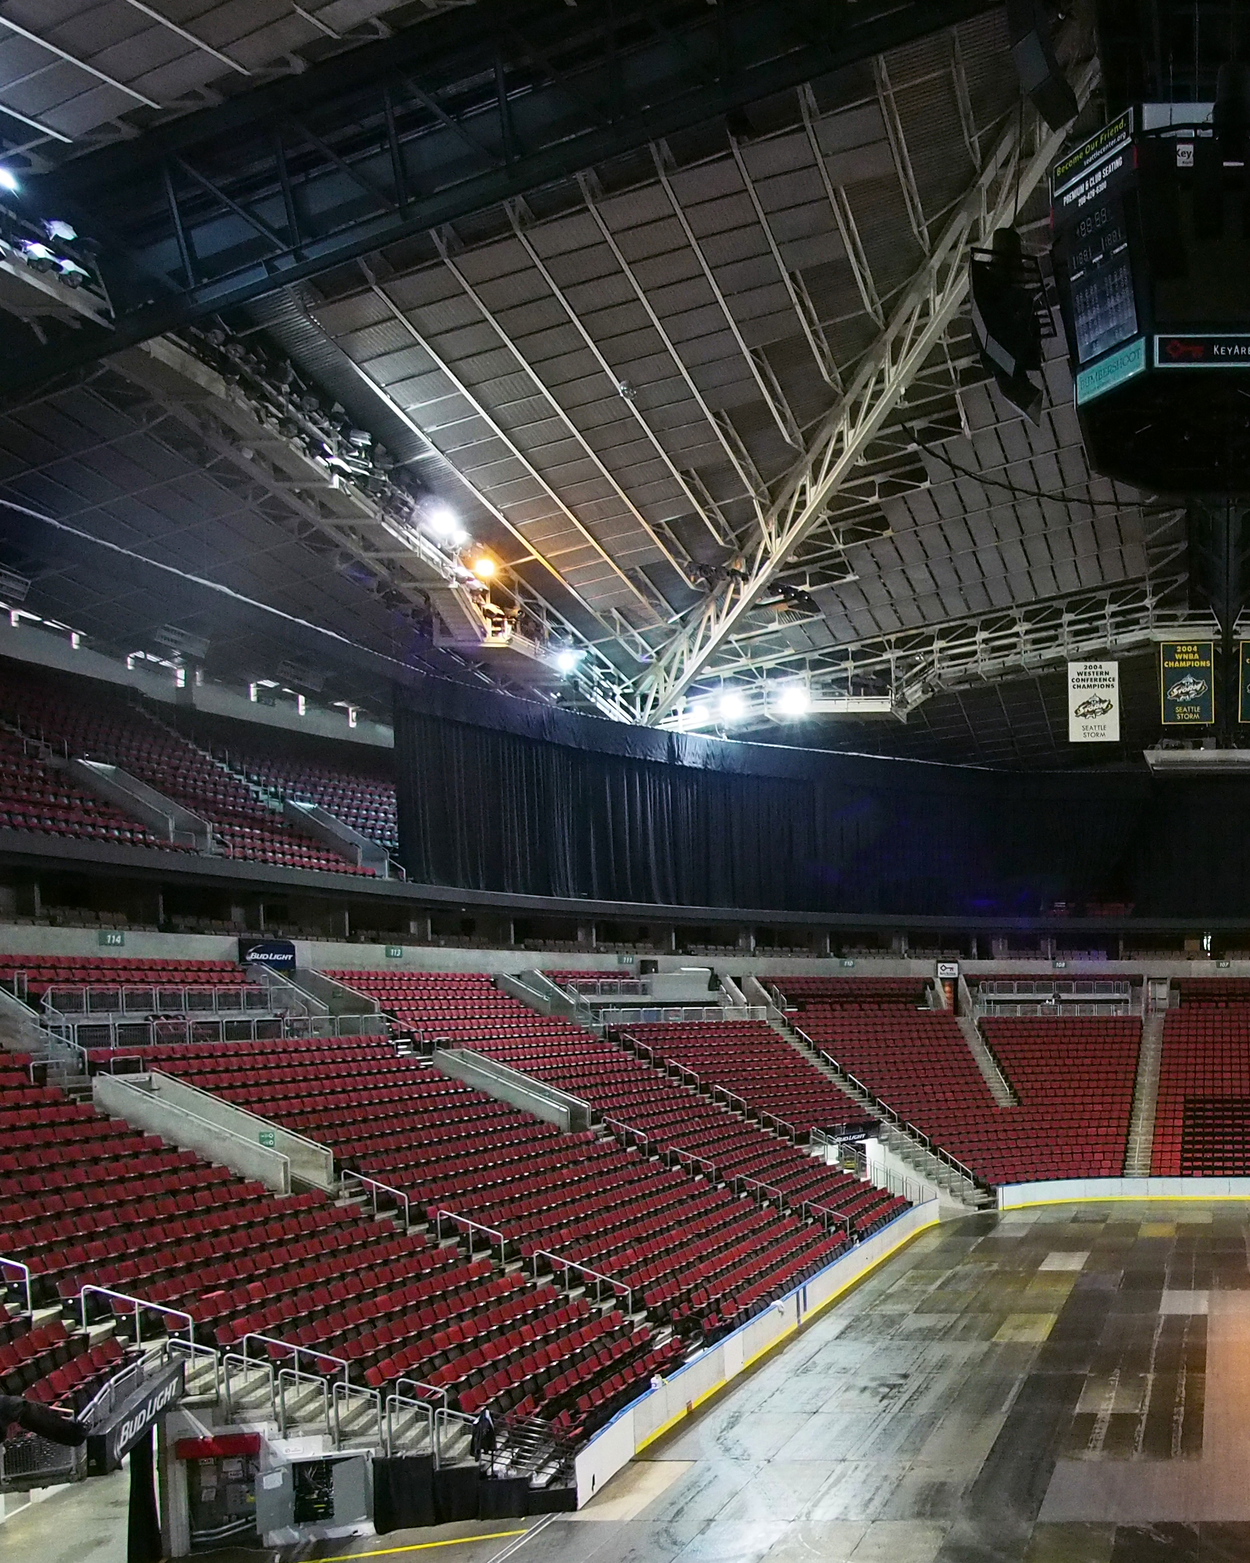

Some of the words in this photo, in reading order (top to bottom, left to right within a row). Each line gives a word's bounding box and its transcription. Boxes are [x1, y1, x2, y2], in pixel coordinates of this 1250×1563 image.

[1057, 151, 1083, 176] Become
[1085, 140, 1098, 155] Our
[1100, 118, 1126, 144] Friend.
[1083, 131, 1126, 166] seattlecenter.org
[1063, 183, 1085, 207] PREMIUM
[1089, 170, 1102, 188] CLUB
[1102, 156, 1123, 179] SEATING
[1164, 660, 1211, 668] CHAMPIONS
[107, 934, 121, 944] 114
[250, 952, 269, 960] BUD
[269, 952, 294, 961] LIGHT
[390, 949, 401, 957] 113
[118, 1409, 146, 1451] BUD
[146, 1376, 179, 1423] LIGHT
